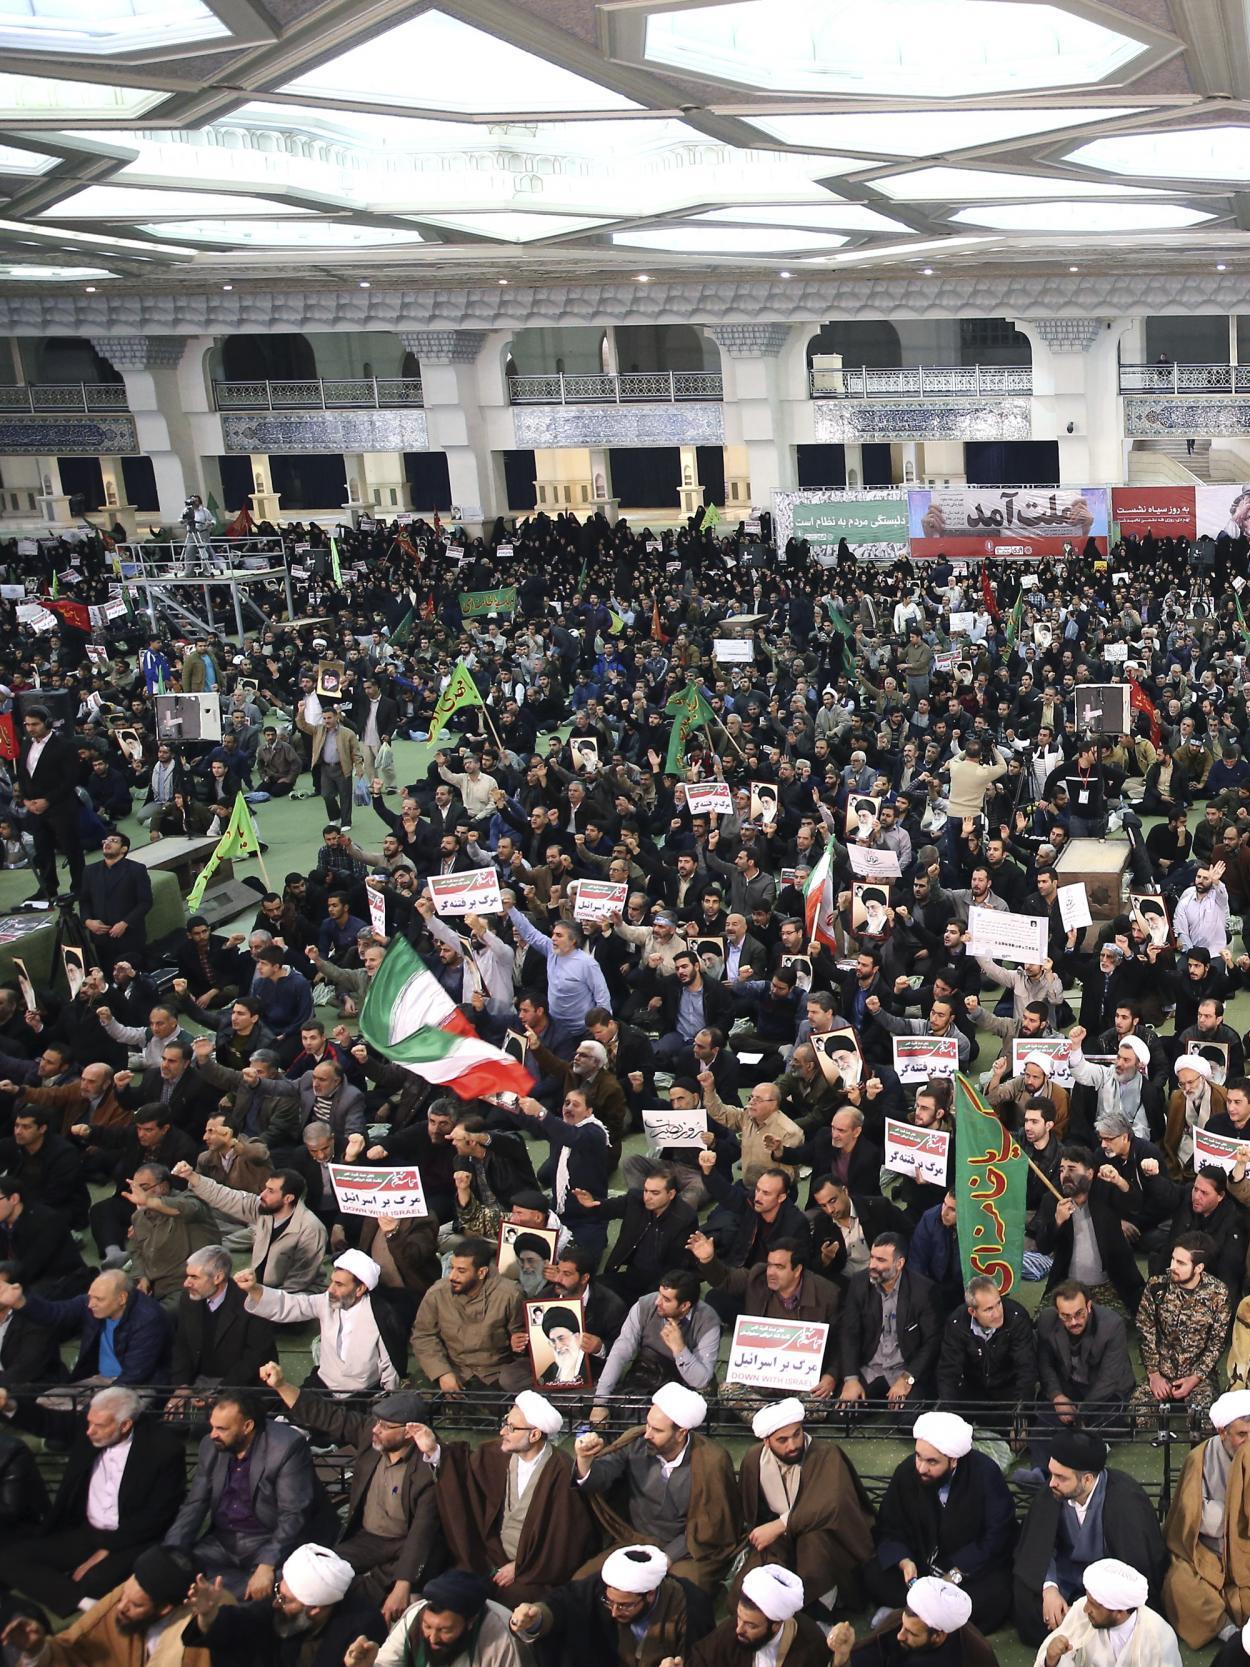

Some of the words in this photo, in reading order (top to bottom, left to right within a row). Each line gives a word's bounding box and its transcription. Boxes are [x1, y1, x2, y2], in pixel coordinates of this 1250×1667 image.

[967, 491, 1019, 528] آمد
[1116, 505, 1147, 514] نشست
[1148, 505, 1168, 515] سیاه
[1168, 505, 1181, 514] روز
[1182, 506, 1190, 514] به
[795, 517, 814, 526] است
[815, 515, 836, 528] نظام
[838, 517, 846, 528] به
[848, 519, 868, 528] مردم
[870, 515, 906, 528] دلبستگی
[479, 895, 499, 907] مرگ
[341, 1192, 377, 1206] اسرائیل
[382, 1199, 390, 1208] بر
[393, 1195, 421, 1207] مرگ
[343, 1205, 367, 1214] DOWN
[391, 1208, 422, 1217] ISRAEL
[734, 1353, 778, 1371] اسرائیل
[780, 1361, 790, 1373] بر
[793, 1360, 818, 1375] مرگ
[731, 1372, 759, 1382] DOWN
[762, 1375, 784, 1384] WITH
[785, 1378, 812, 1387] ISRAEL
